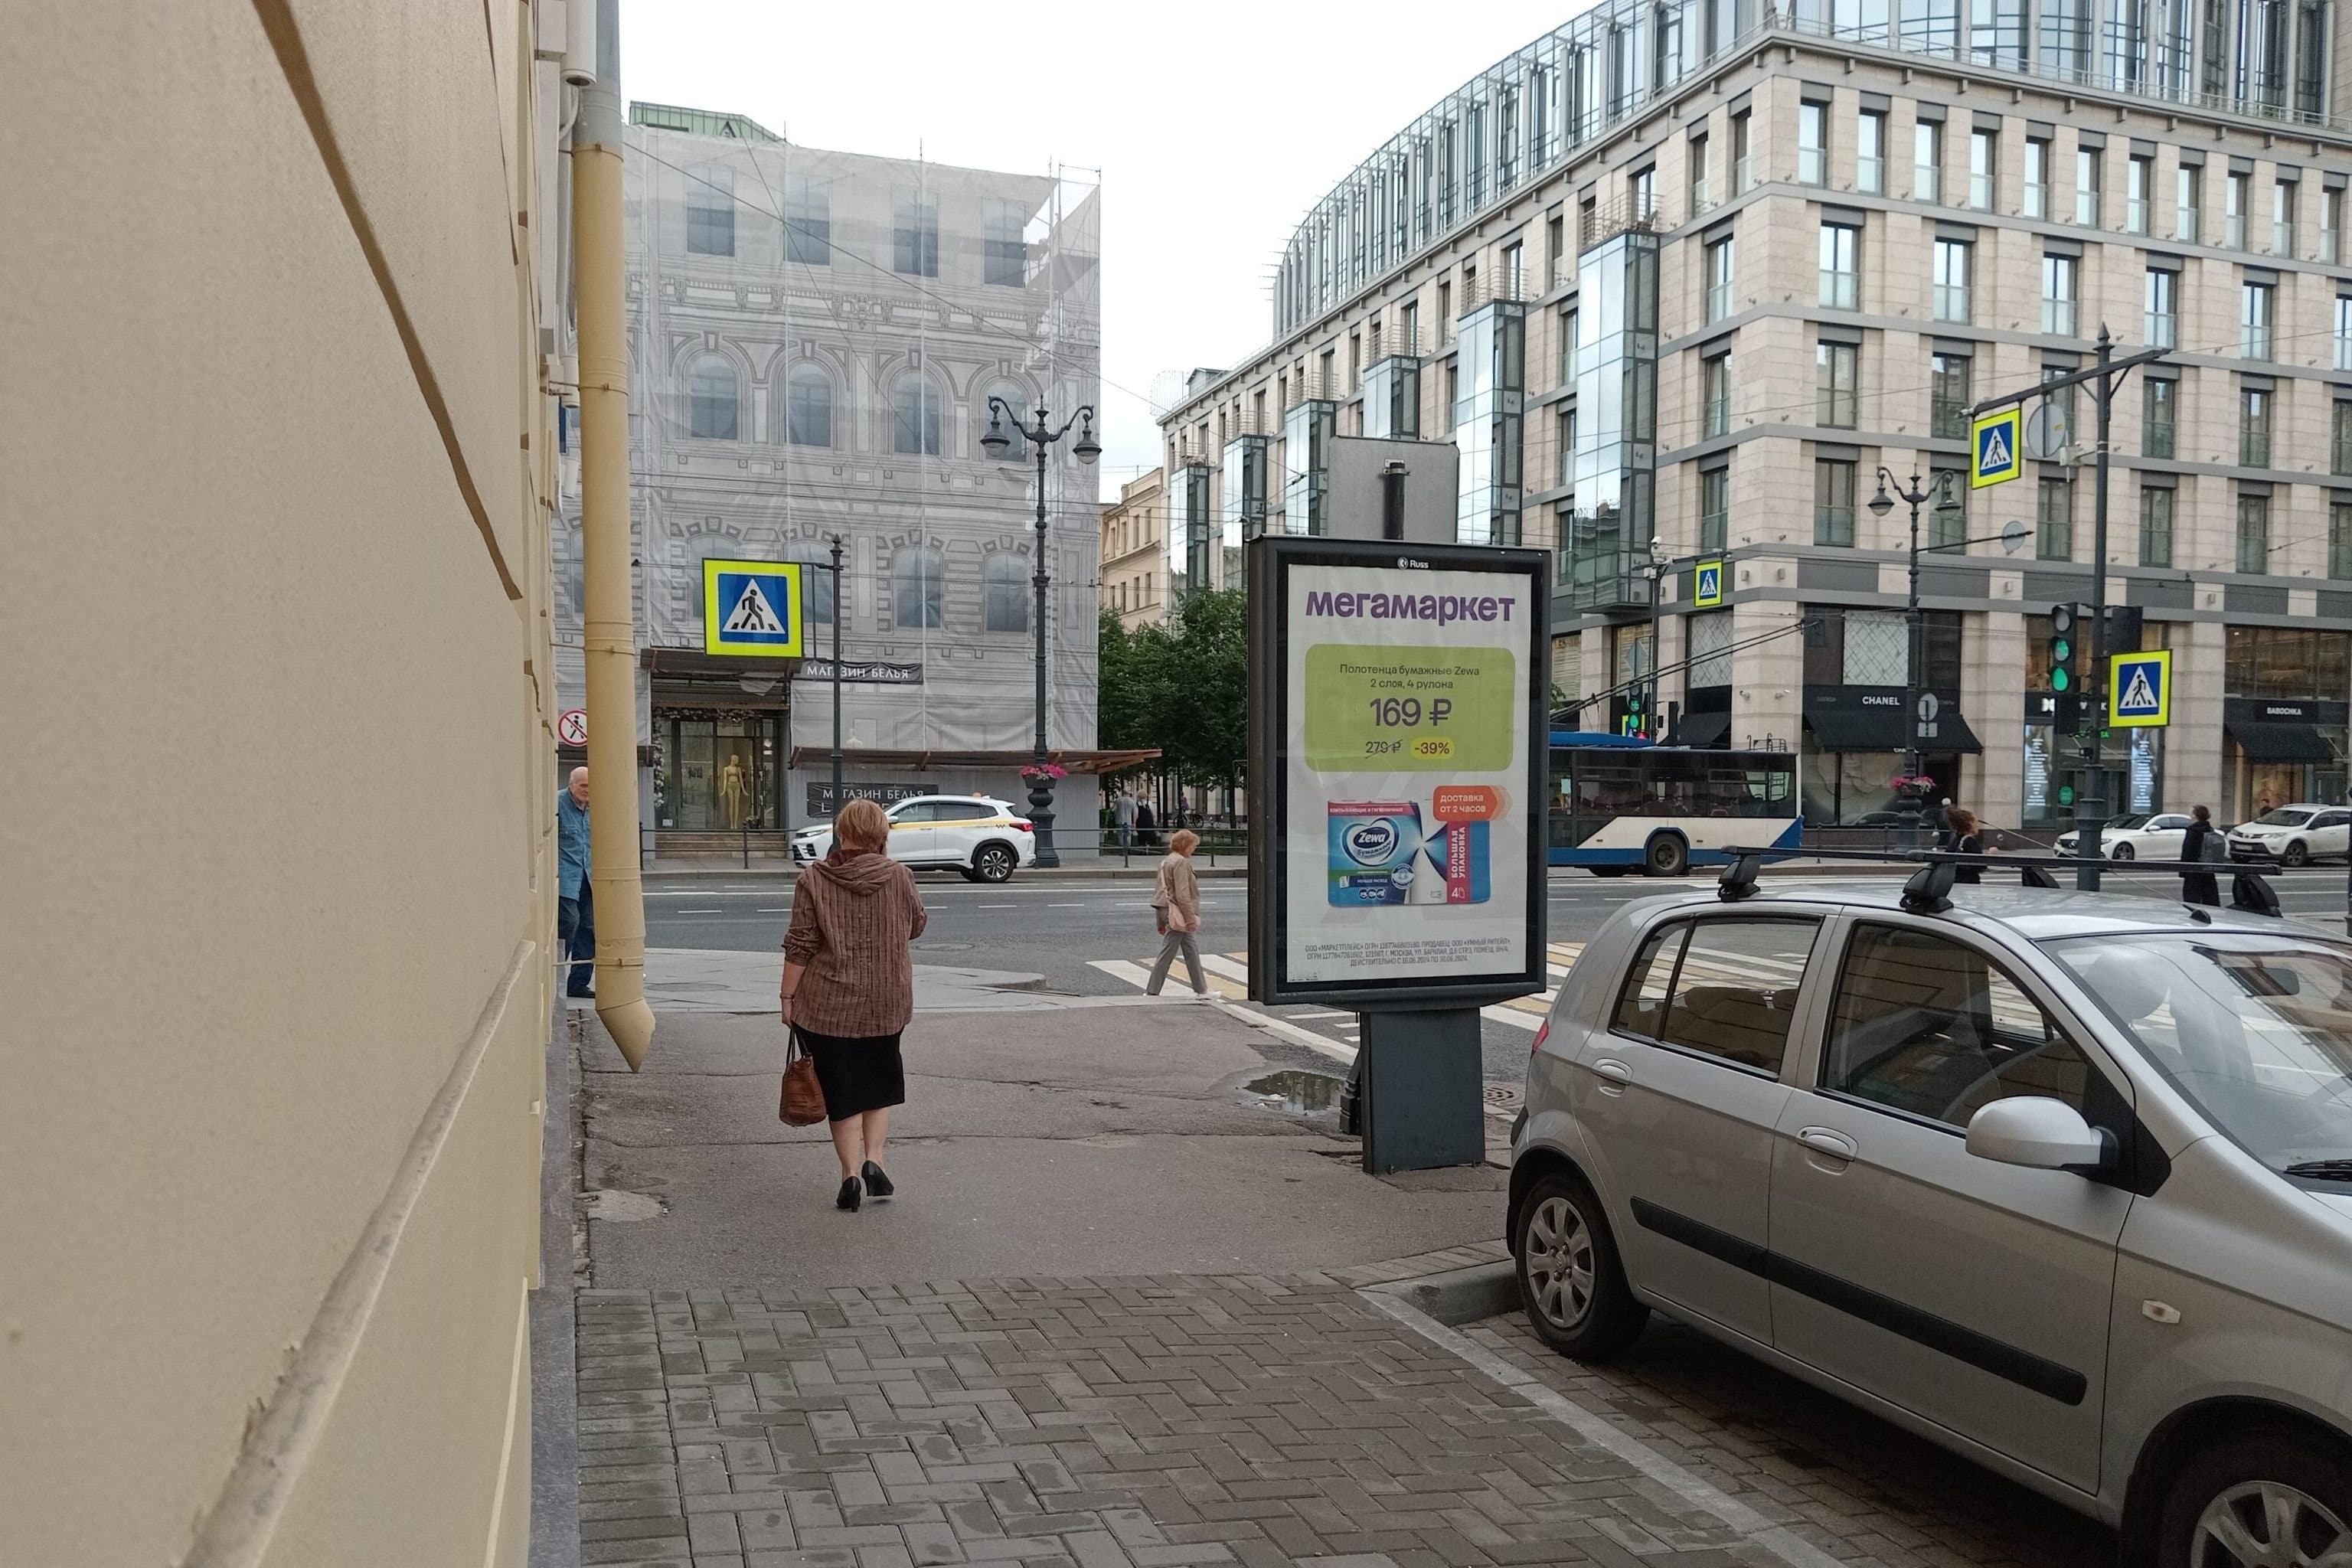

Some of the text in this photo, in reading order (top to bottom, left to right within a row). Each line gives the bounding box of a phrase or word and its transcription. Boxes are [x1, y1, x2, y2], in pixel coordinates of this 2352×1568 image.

[1410, 559, 1429, 569] Russ
[1305, 590, 1515, 626] мегамаркет
[807, 666, 909, 679] МАГЗИН БЕЛЬЯ
[1340, 664, 1480, 677] Полотенца бумажные Zewa
[1370, 679, 1453, 691] 2 слоя, 4 рулона
[1862, 696, 1900, 705] CHANEL
[1370, 697, 1422, 727] 169
[1365, 741, 1389, 753] 279
[1415, 742, 1450, 754] -39%
[822, 789, 924, 800] МГАЗИН БЕЛЬЯ
[1440, 795, 1484, 803] доставка
[1358, 832, 1387, 843] Zewa
[1451, 887, 1459, 898] 4
